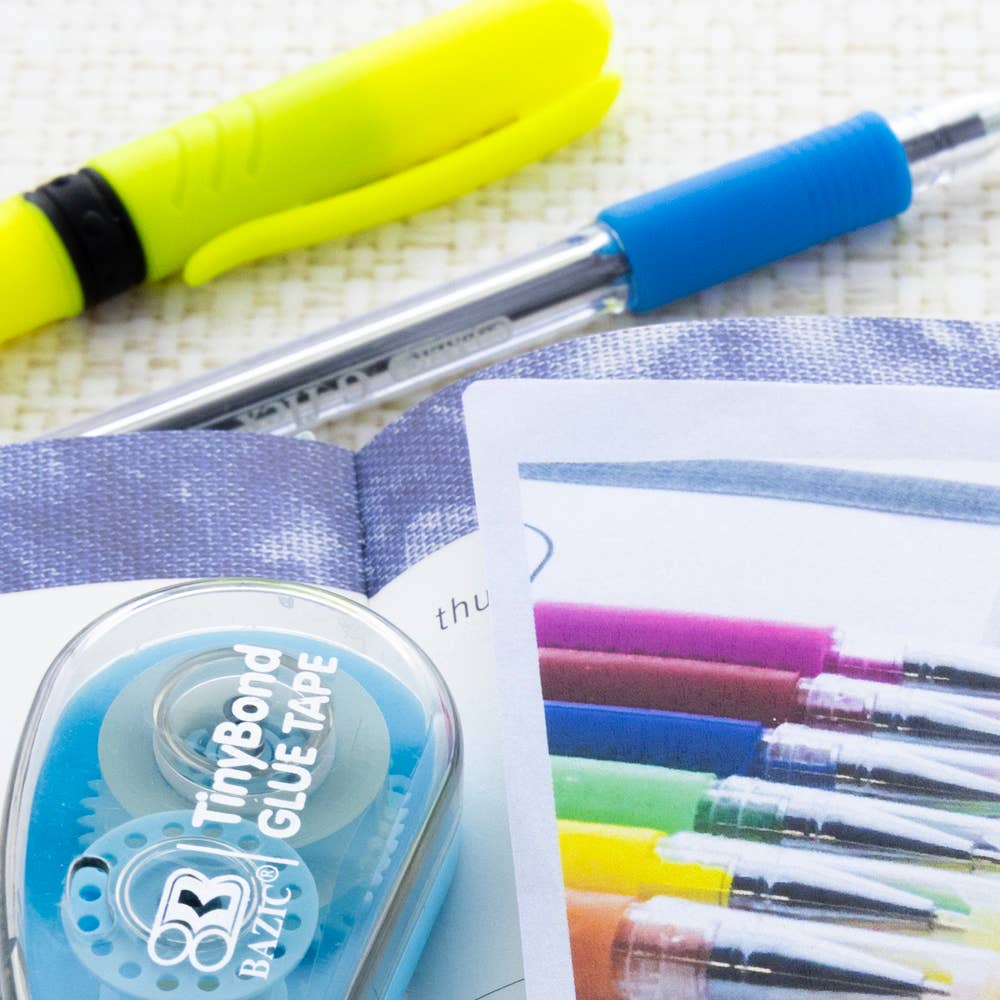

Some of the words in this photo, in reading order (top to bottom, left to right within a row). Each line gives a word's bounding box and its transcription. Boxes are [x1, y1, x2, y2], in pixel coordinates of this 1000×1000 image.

[192, 644, 282, 828] TinyBond
[282, 652, 338, 733] TAPE
[258, 743, 317, 839] GLUE
